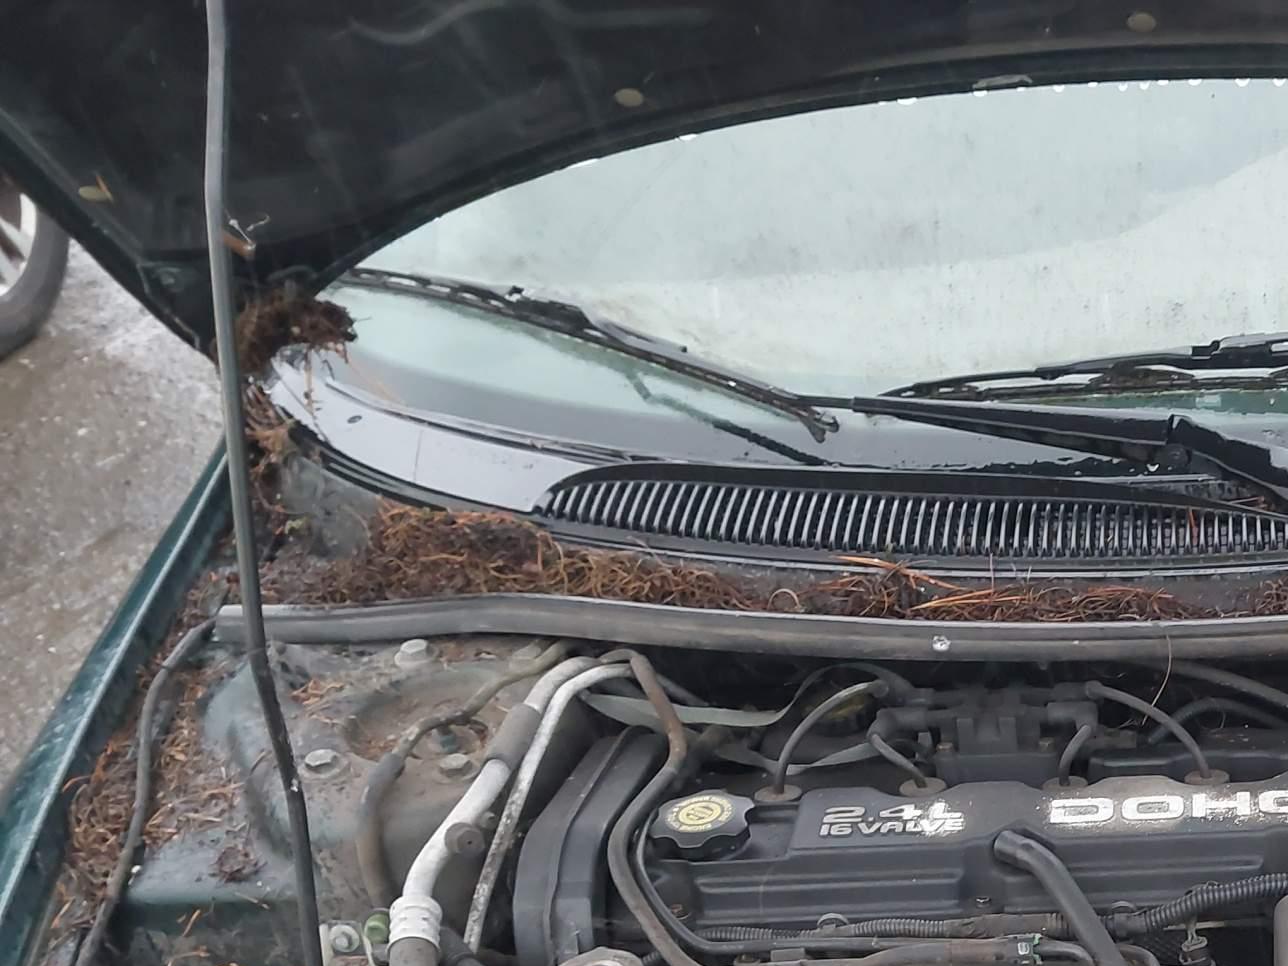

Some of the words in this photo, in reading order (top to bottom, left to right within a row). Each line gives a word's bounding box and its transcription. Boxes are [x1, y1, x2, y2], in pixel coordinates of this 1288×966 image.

[823, 800, 964, 823] 2.4L
[820, 823, 853, 836] 16
[858, 819, 964, 835] VALVE
